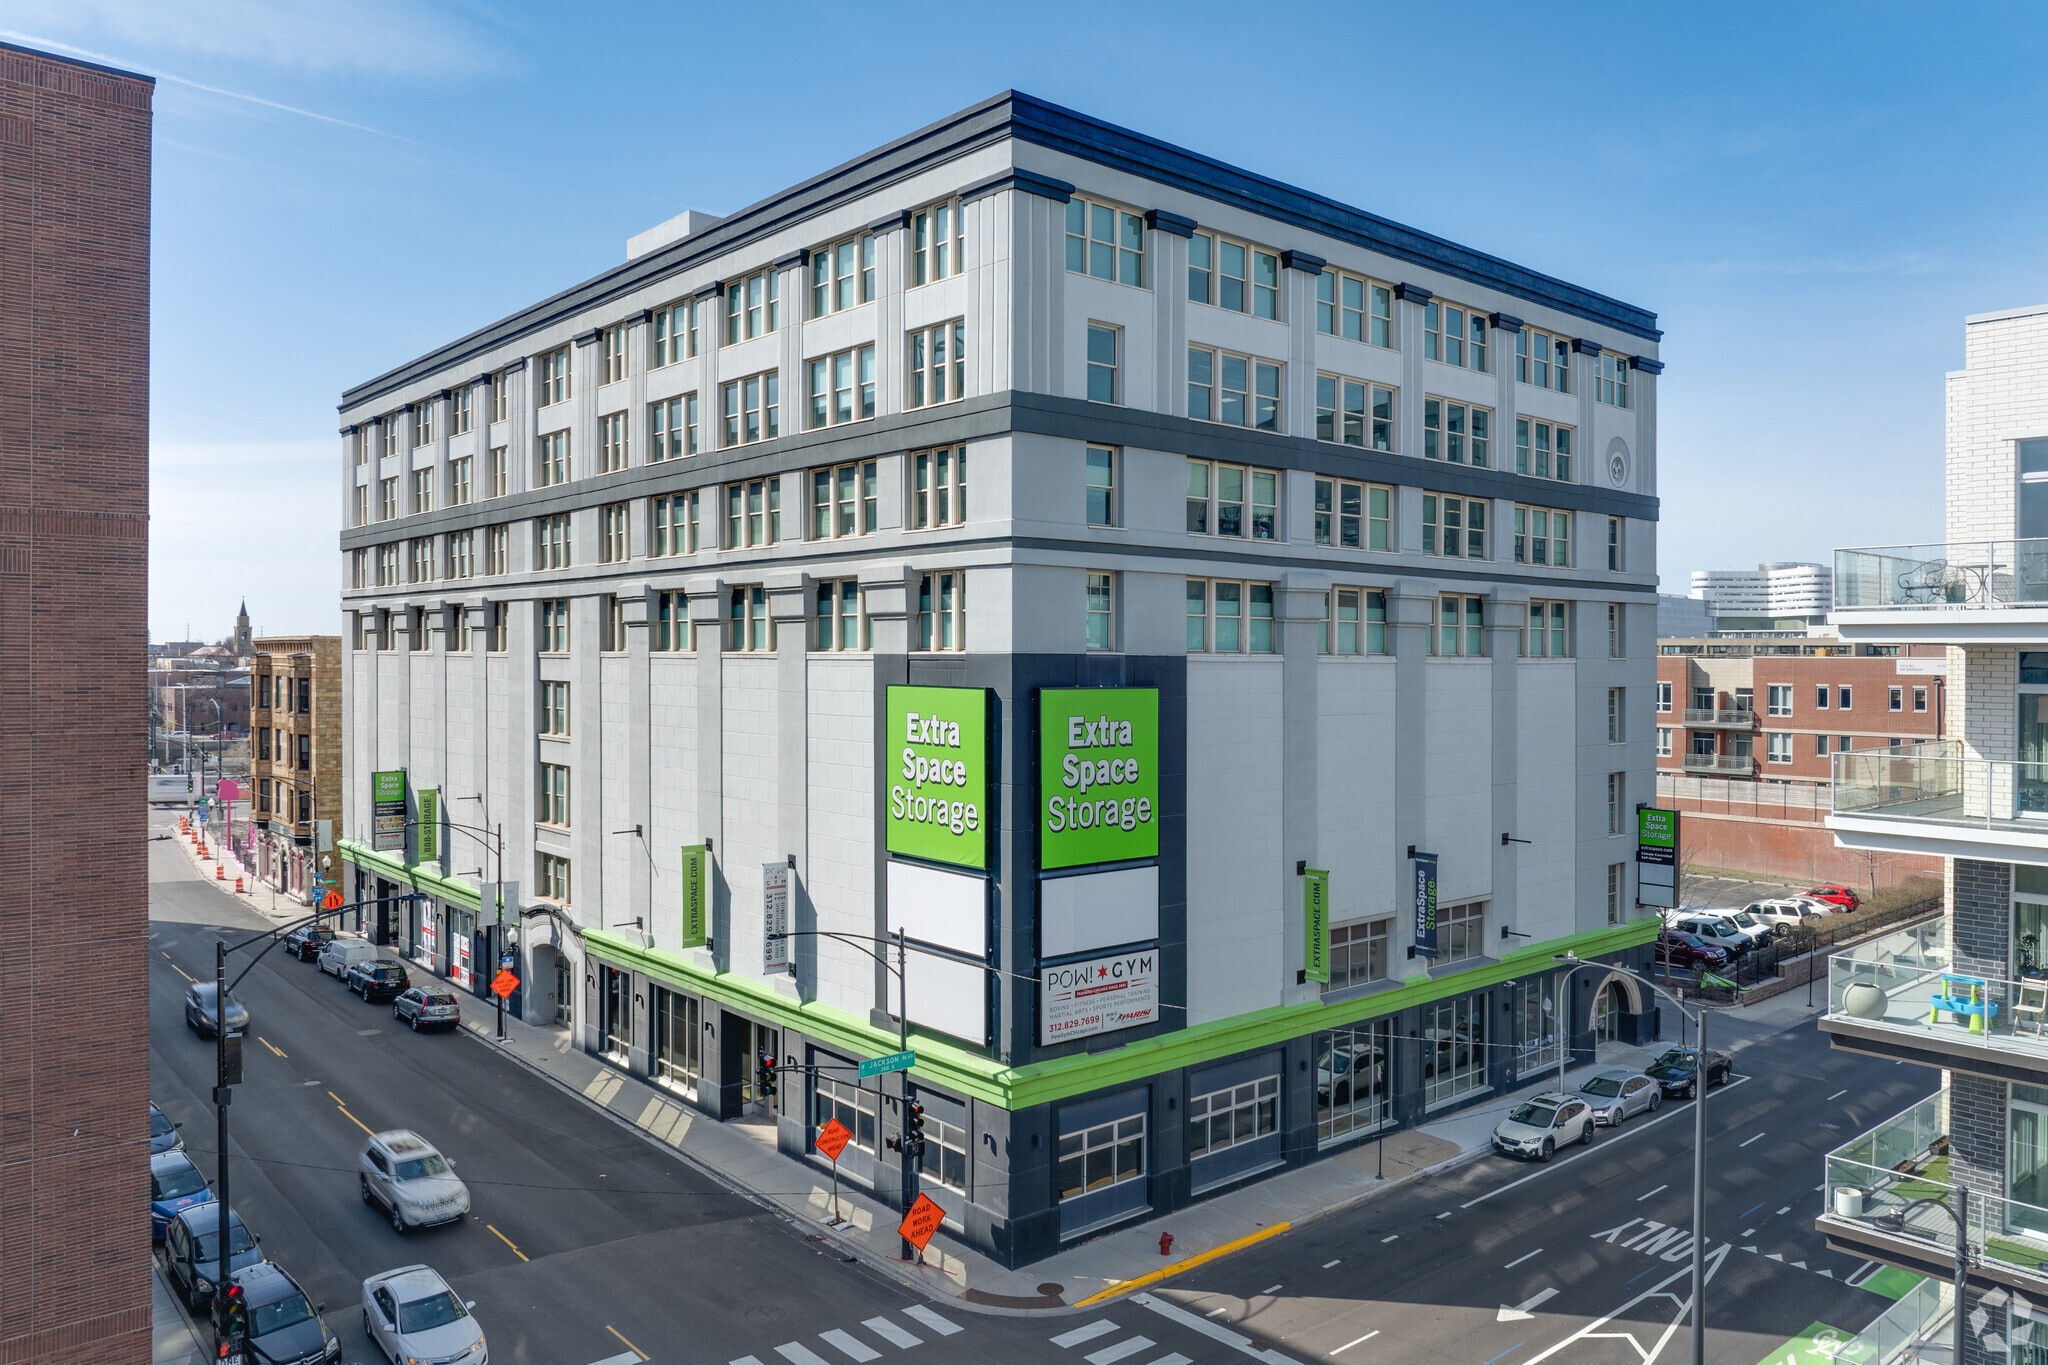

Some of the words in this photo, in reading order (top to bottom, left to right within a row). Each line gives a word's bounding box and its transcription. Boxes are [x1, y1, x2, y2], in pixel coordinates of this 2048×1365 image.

[907, 712, 960, 747] Extra
[1068, 715, 1133, 748] Extra
[902, 748, 966, 788] Space
[1062, 753, 1139, 793] Space
[424, 798, 432, 853] 888-STORAGE
[892, 785, 978, 834] Storage
[1048, 795, 1152, 832] Storage
[1646, 822, 1667, 830] Space
[1647, 814, 1666, 822] Extra
[1642, 830, 1672, 840] Storage
[690, 857, 698, 935] EXTRASPACE.COM
[1416, 870, 1427, 938] ExtraSpace
[1426, 881, 1437, 931] Storage
[1048, 966, 1093, 991] POW!
[1112, 956, 1152, 978] GYM
[1049, 1004, 1070, 1013] BOXING
[1074, 1000, 1096, 1008] FITNESS
[1100, 994, 1127, 1003] PERSONAL
[1128, 988, 1151, 997] TRAINING
[1049, 1011, 1073, 1020] MARTIAL
[1092, 1002, 1113, 1011] SPORTS
[1113, 995, 1151, 1008] PERFORMANCE
[1049, 1014, 1100, 1033] 312.829.7699
[869, 1056, 899, 1068] JACKSON
[819, 1133, 849, 1145] CONSTRUCTION
[912, 1203, 931, 1216] ROAD
[912, 1215, 931, 1227] WORK
[910, 1225, 934, 1239] AHEAD
[1590, 1217, 1710, 1262] ONLY
